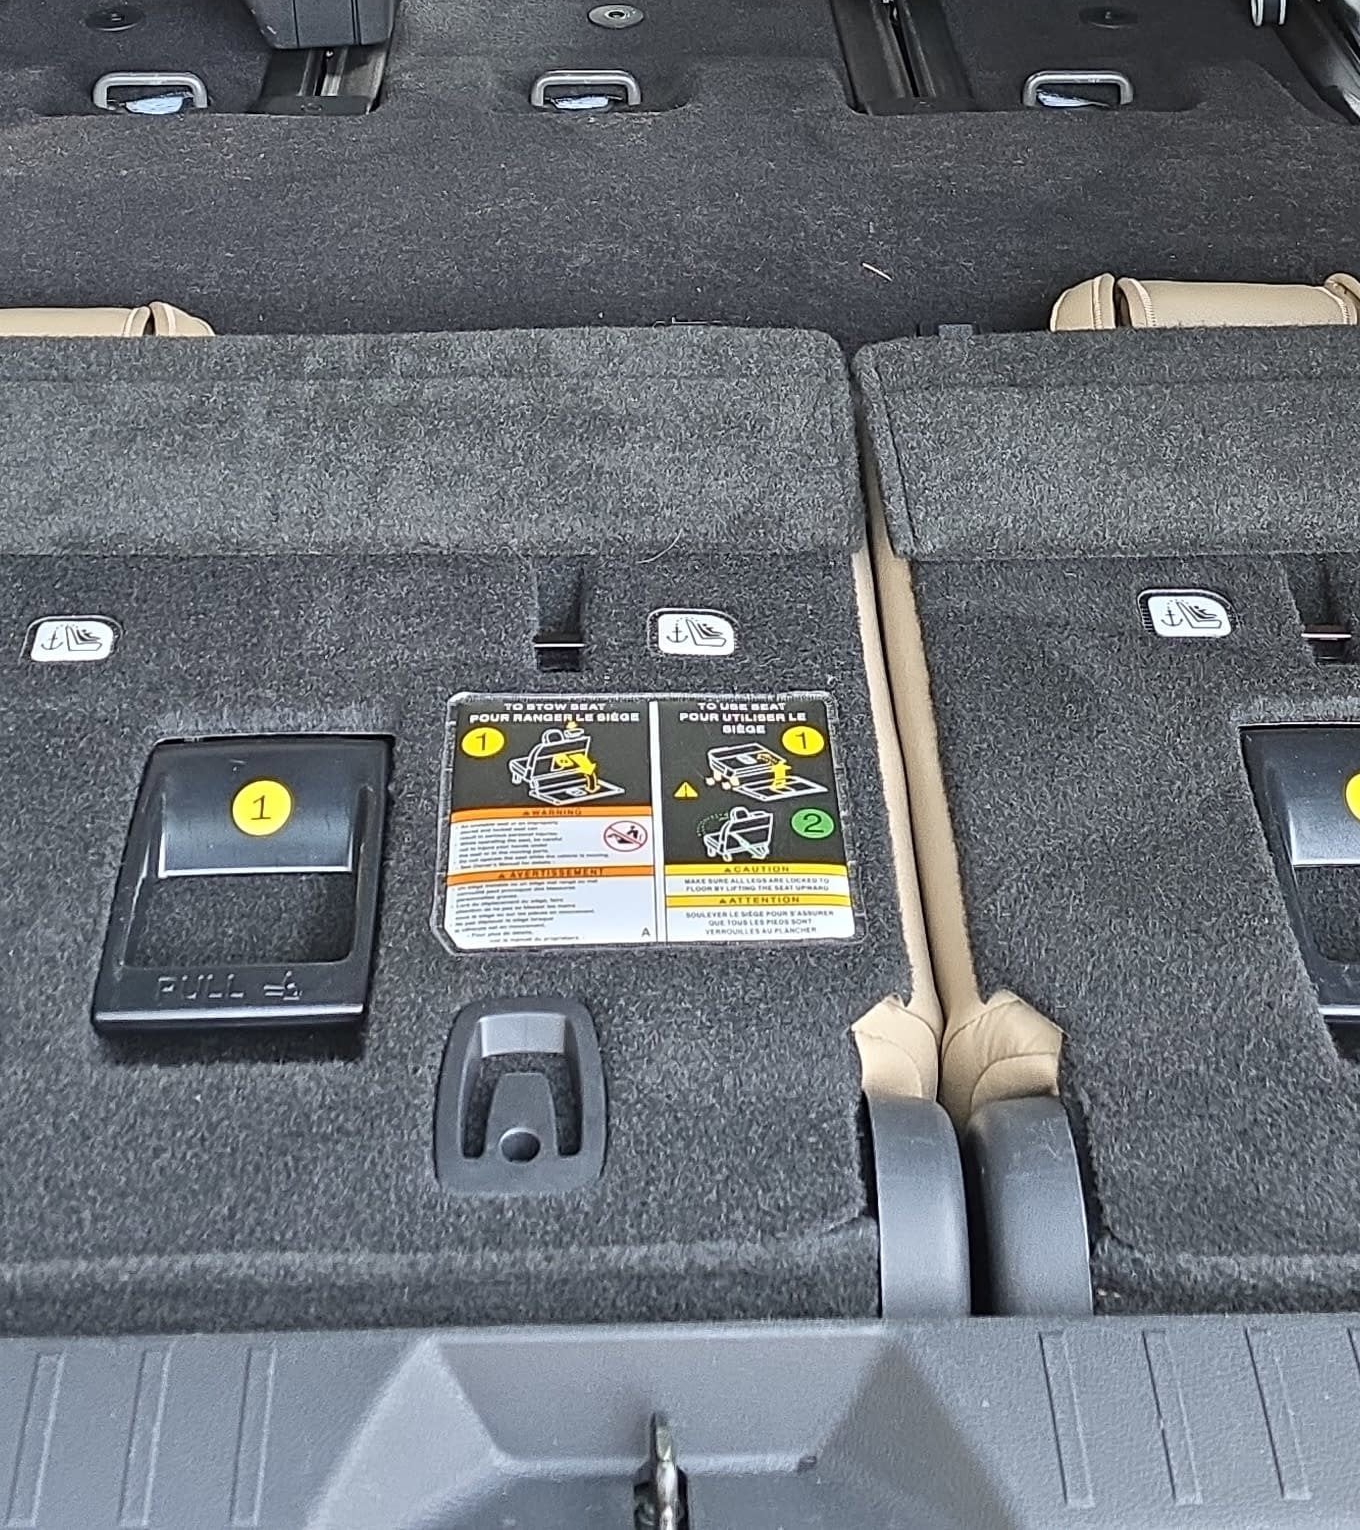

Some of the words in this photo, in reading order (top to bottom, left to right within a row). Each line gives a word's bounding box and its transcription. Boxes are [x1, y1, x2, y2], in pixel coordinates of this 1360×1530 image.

[504, 703, 523, 711] TO
[526, 703, 566, 711] STOW
[568, 703, 606, 711] SEAT
[697, 703, 717, 711] TO
[720, 703, 748, 711] USE
[750, 703, 787, 711] SEAT
[469, 713, 510, 723] POUR
[513, 713, 572, 723] RANGER
[576, 713, 594, 722] LE
[679, 713, 719, 722] POUR
[723, 713, 786, 722] UTILISER
[789, 713, 806, 721] LE
[475, 733, 486, 751] 1
[795, 732, 807, 749] 1
[251, 794, 272, 821] 1
[532, 808, 582, 816] WARNING
[803, 813, 825, 833] 2
[510, 867, 604, 879] AVERTISSEMENT
[734, 866, 790, 874] CAUTION
[641, 927, 651, 938] A
[158, 973, 244, 1001] PULL
